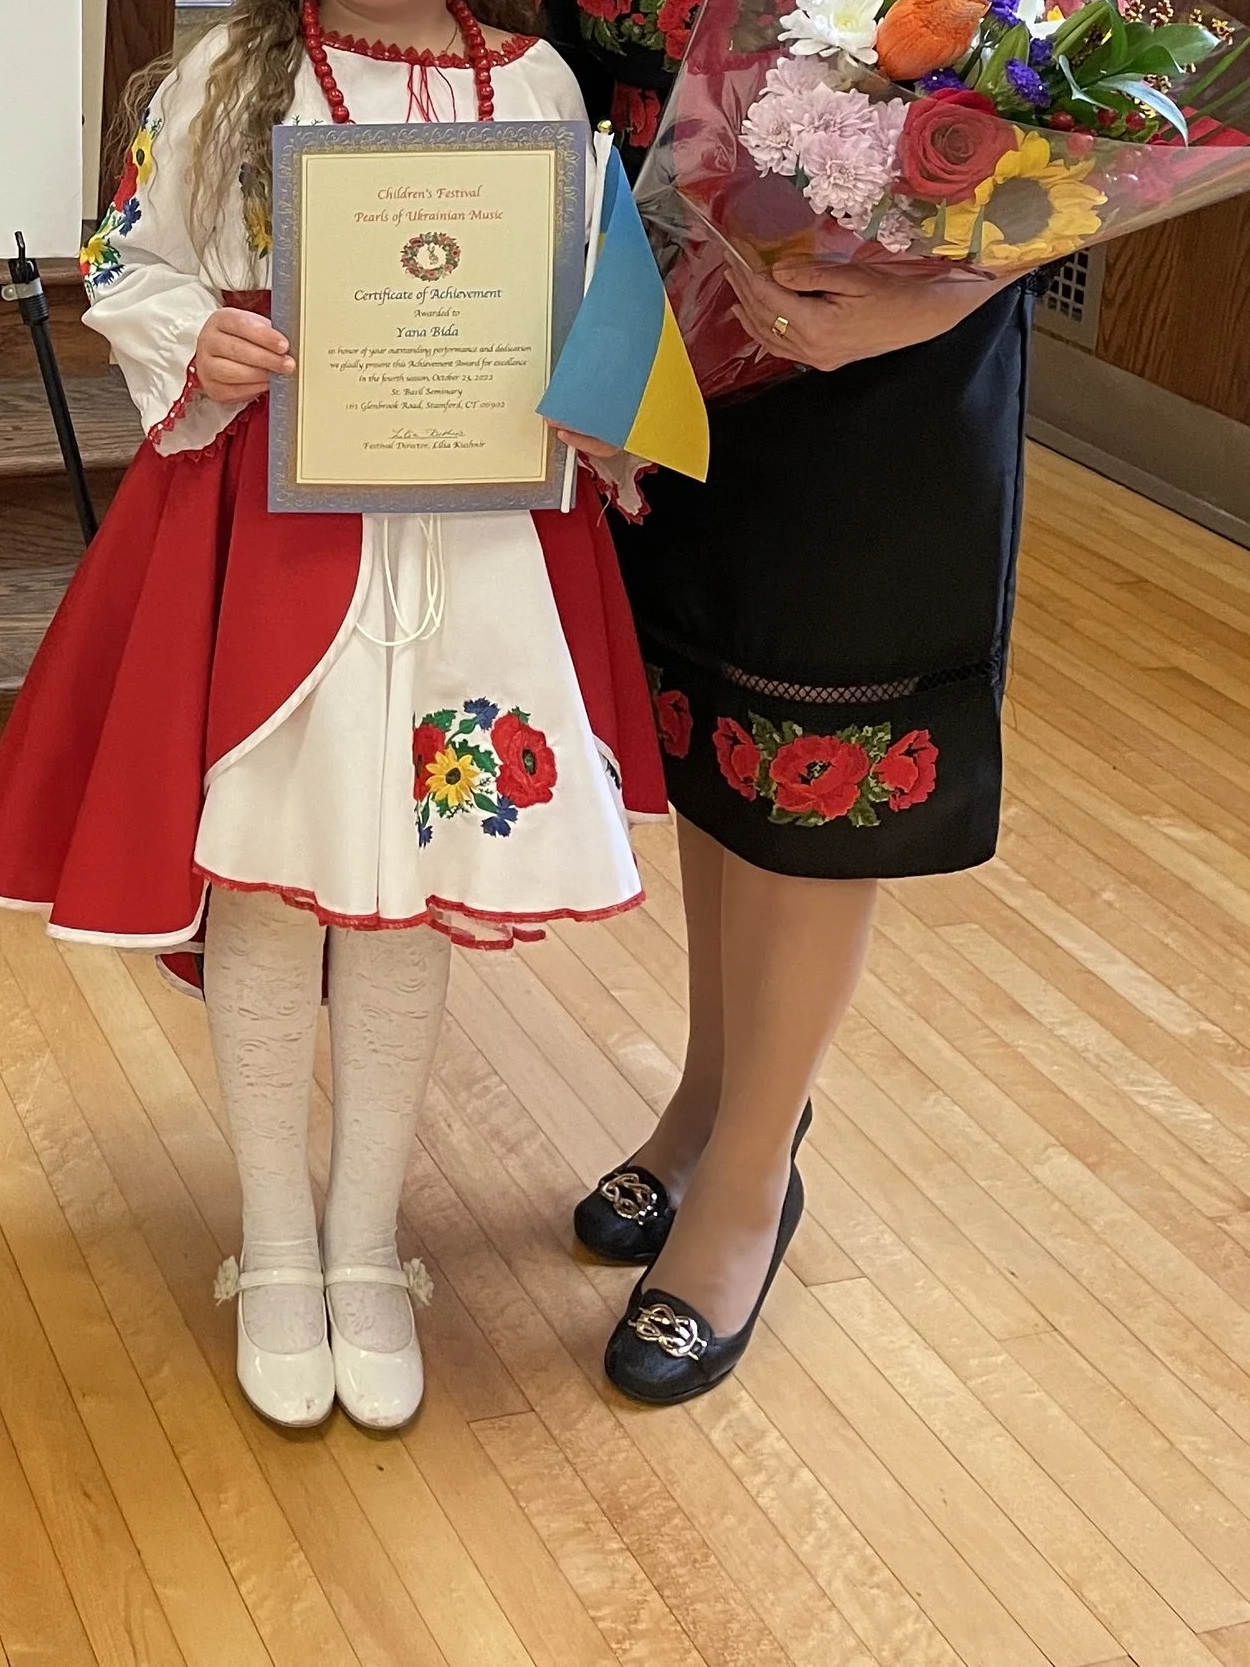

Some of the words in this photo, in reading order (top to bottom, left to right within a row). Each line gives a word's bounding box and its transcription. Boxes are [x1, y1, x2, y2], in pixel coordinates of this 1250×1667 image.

[436, 185, 483, 199] Festival
[354, 209, 389, 223] Pearls
[392, 208, 404, 227] of
[405, 209, 465, 222] Ukrainian
[468, 209, 503, 221] Music
[354, 287, 413, 306] Certificate
[416, 286, 430, 305] of
[430, 286, 502, 300] Achievement
[414, 307, 451, 318] Awarded
[452, 309, 461, 317] to
[396, 327, 427, 338] Yana
[430, 324, 459, 337] Bida
[479, 343, 494, 353] and
[363, 441, 394, 450] Festival
